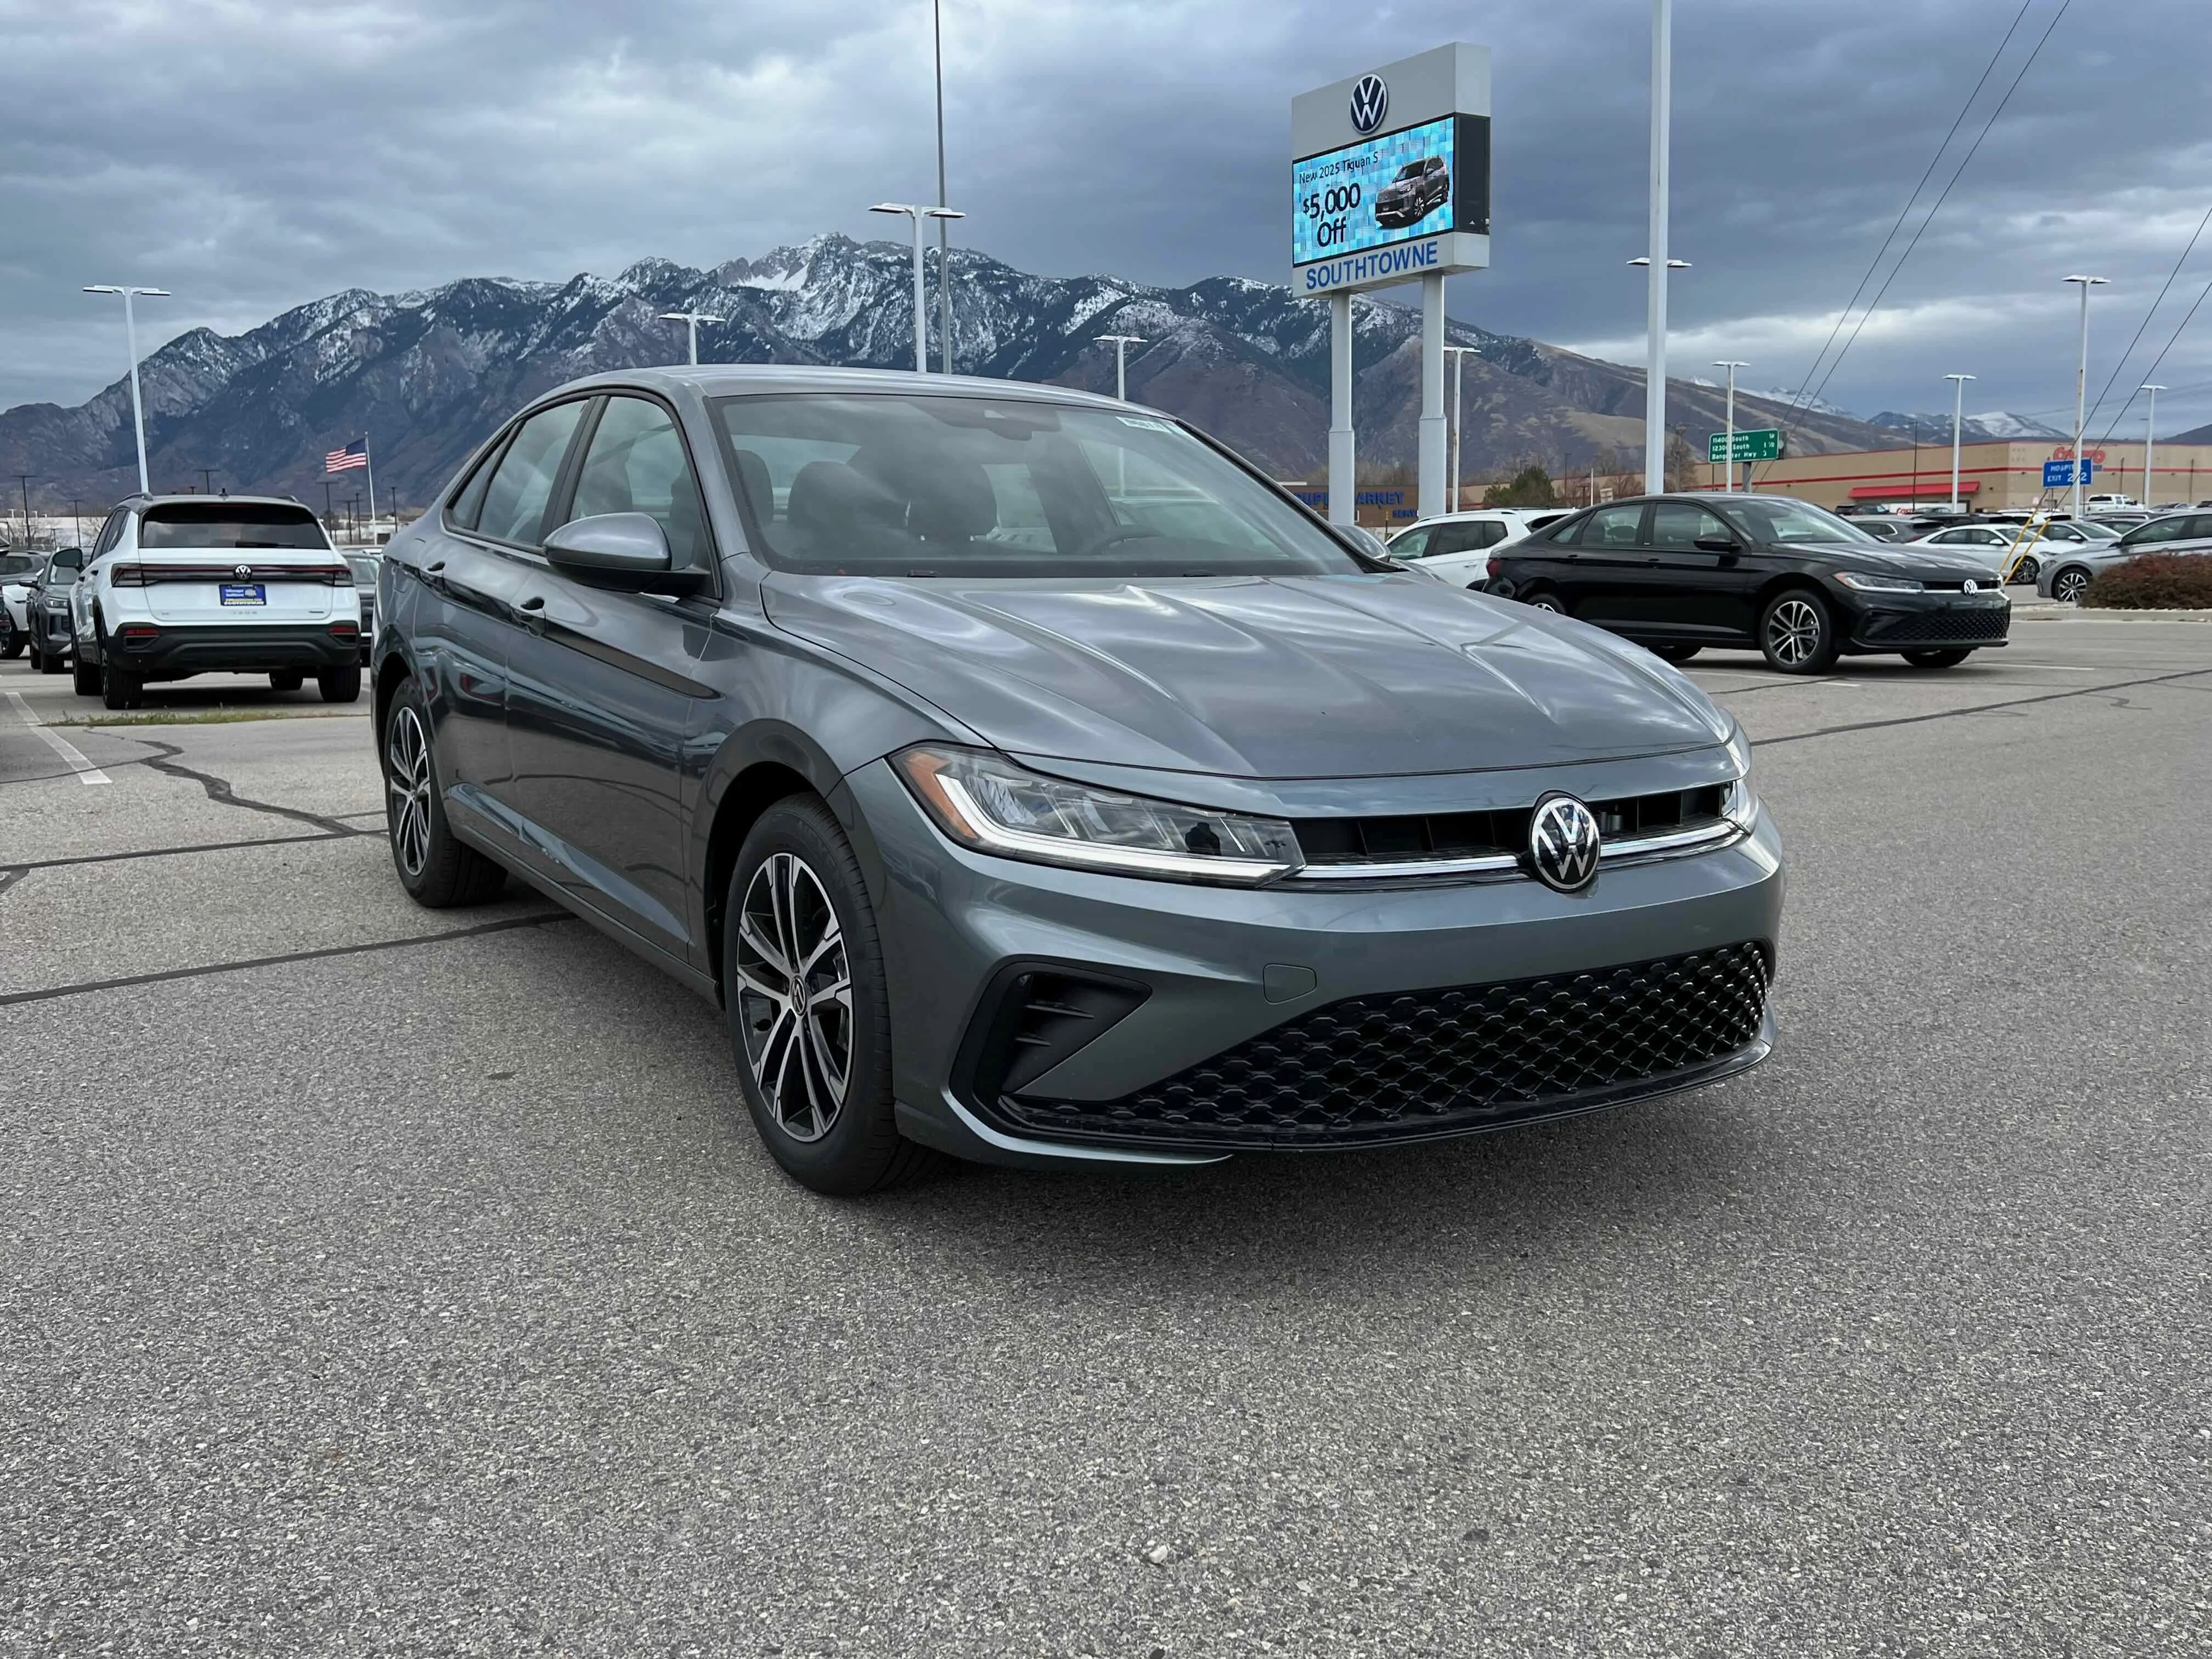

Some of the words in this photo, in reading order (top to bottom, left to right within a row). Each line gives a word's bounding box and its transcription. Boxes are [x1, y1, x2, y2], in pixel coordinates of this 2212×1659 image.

[1299, 172, 1317, 184] New
[1319, 162, 1340, 178] 2025
[1342, 156, 1370, 176] Tiguan
[1373, 151, 1378, 163] S
[1303, 183, 1361, 222] $5,000
[1317, 216, 1347, 247] Off
[1306, 241, 1438, 290] SOUTHTOWNE
